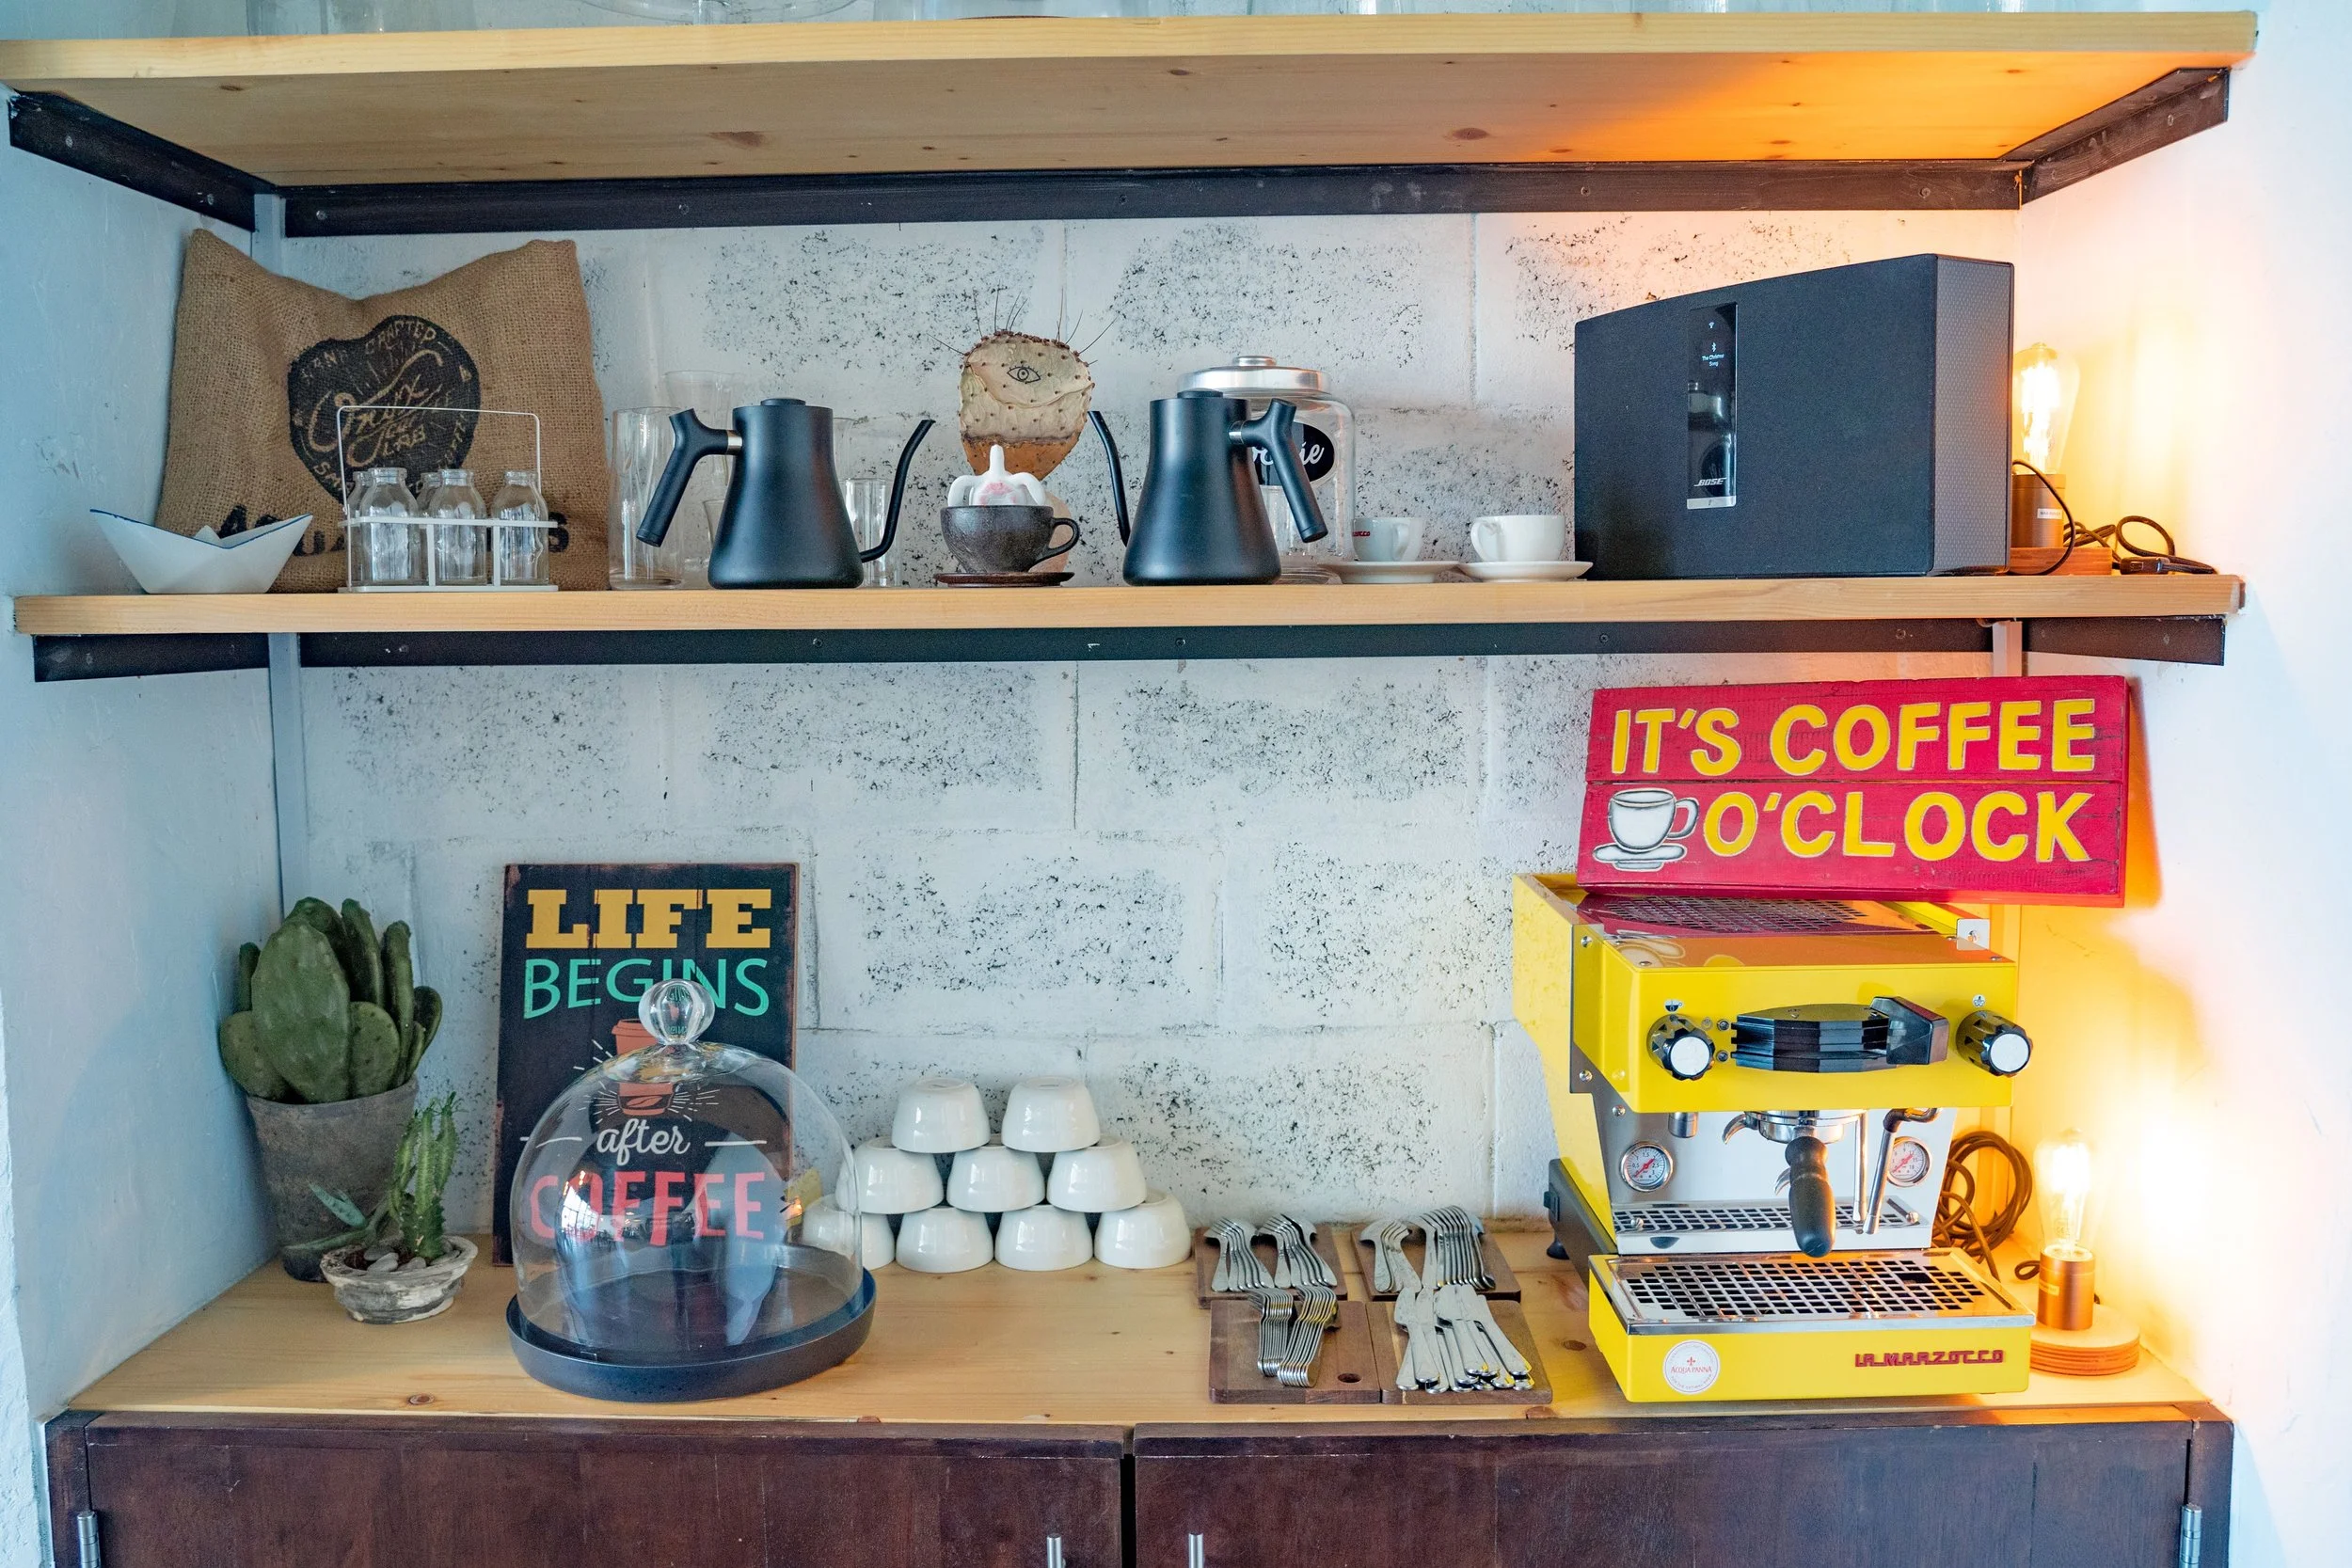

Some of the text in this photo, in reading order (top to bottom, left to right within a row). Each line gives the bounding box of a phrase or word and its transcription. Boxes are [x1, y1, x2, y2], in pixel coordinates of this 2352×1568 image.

[1693, 477, 1727, 487] BOSE
[1611, 699, 2096, 776] IT'S COFFEE
[1703, 790, 2096, 863] O'CLOCK
[526, 889, 771, 948] LIFE
[596, 1117, 691, 1166] after
[530, 1170, 766, 1246] COFFEE
[1671, 1366, 1691, 1374] ACQUA
[1855, 1349, 2004, 1368] LA MARZOCCO
